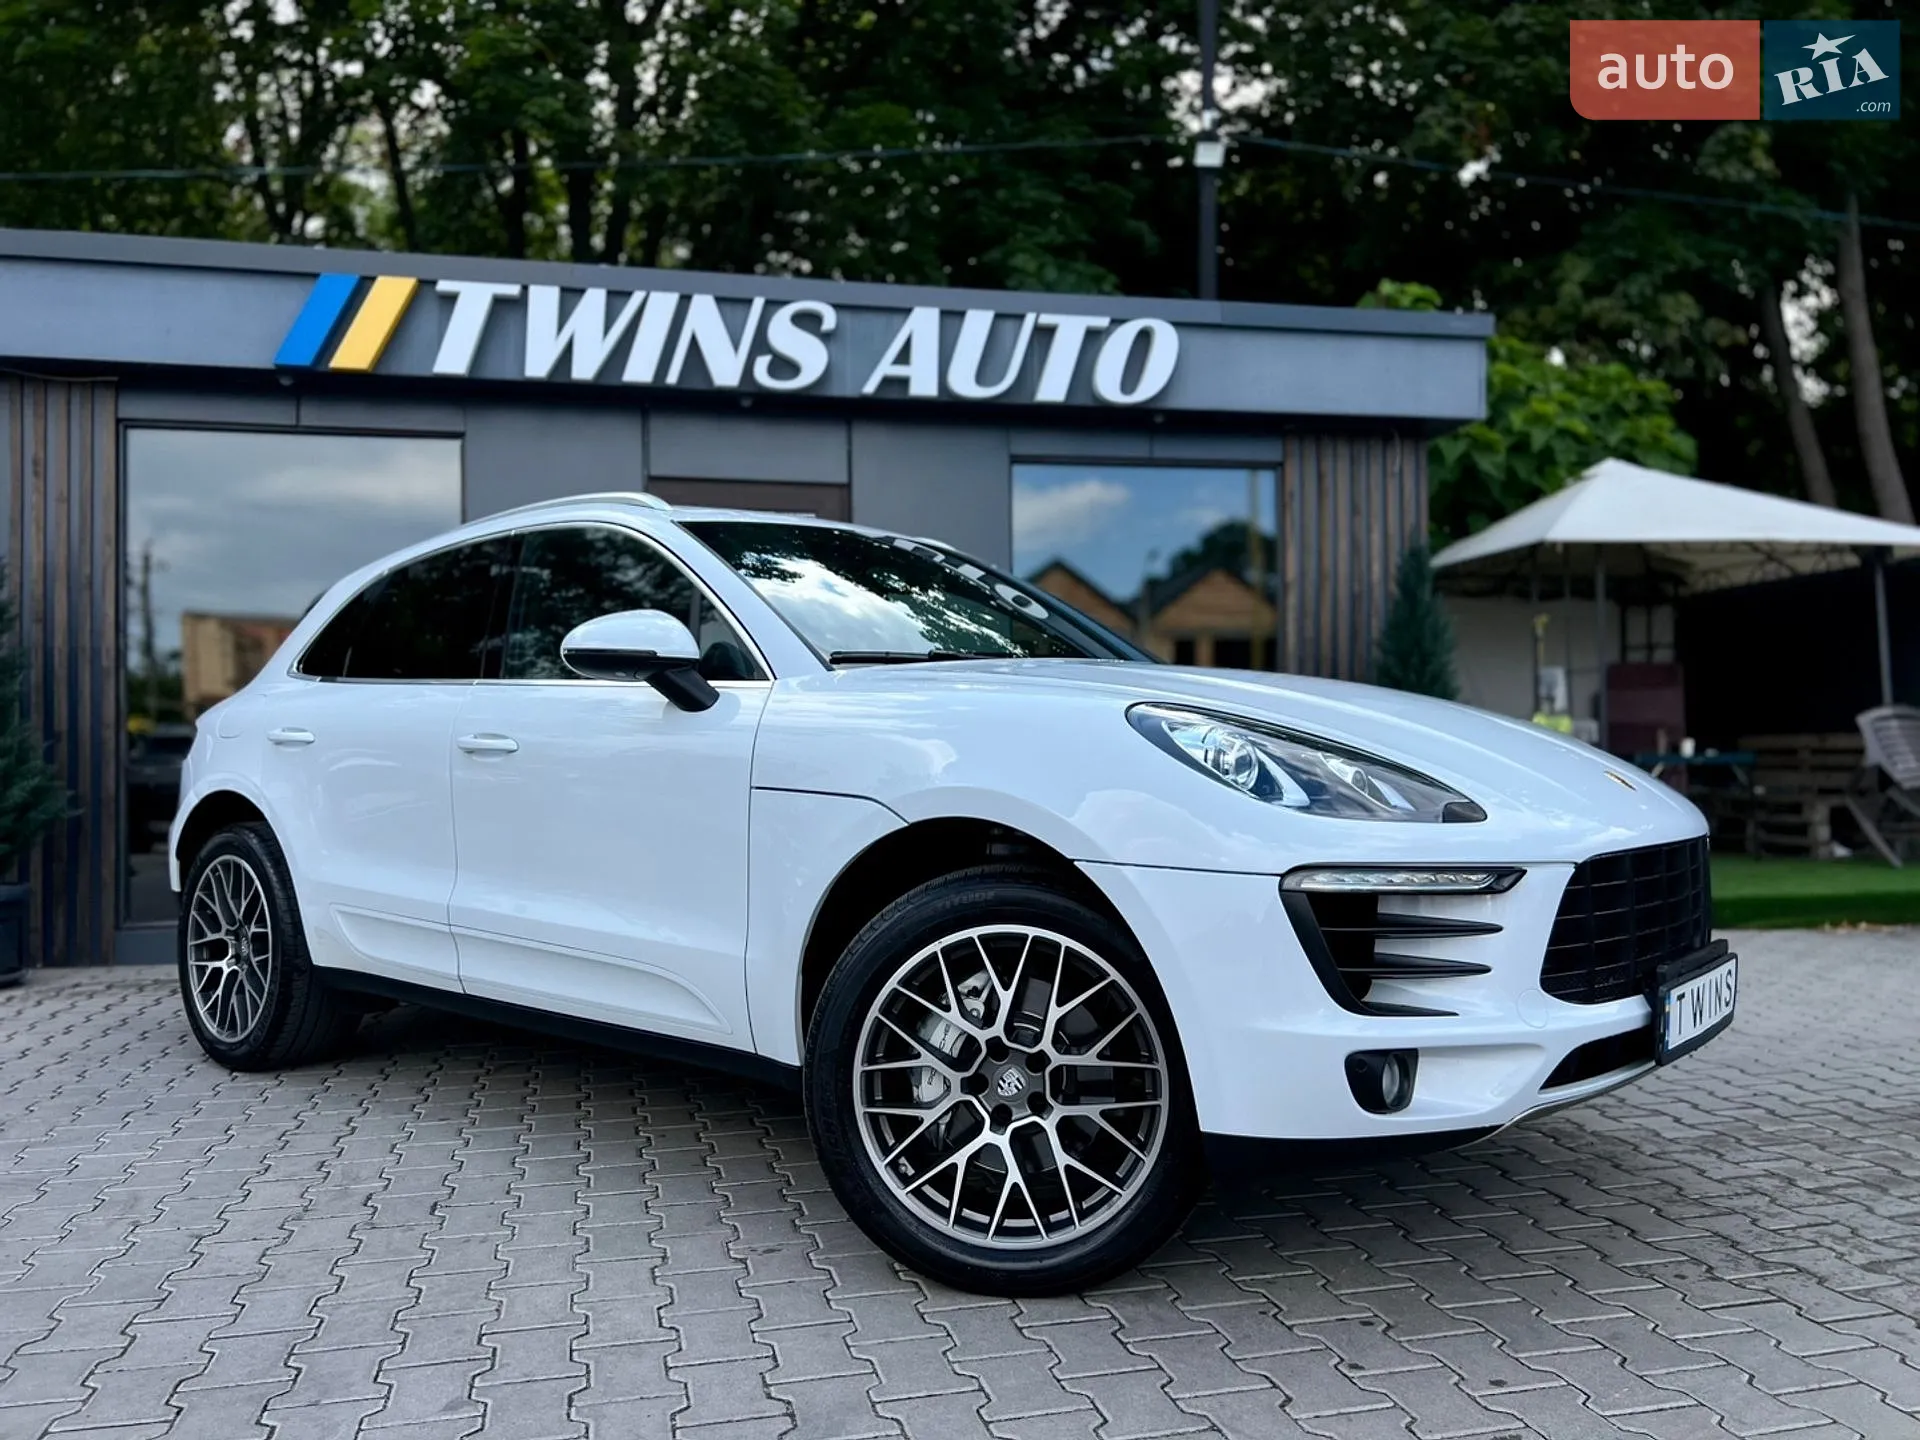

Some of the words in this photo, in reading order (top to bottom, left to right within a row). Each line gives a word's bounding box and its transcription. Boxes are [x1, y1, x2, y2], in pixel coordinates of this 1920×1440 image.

[432, 279, 837, 392] TWINS
[862, 305, 1180, 404] AUTO
[1676, 968, 1732, 1035] TWINS
